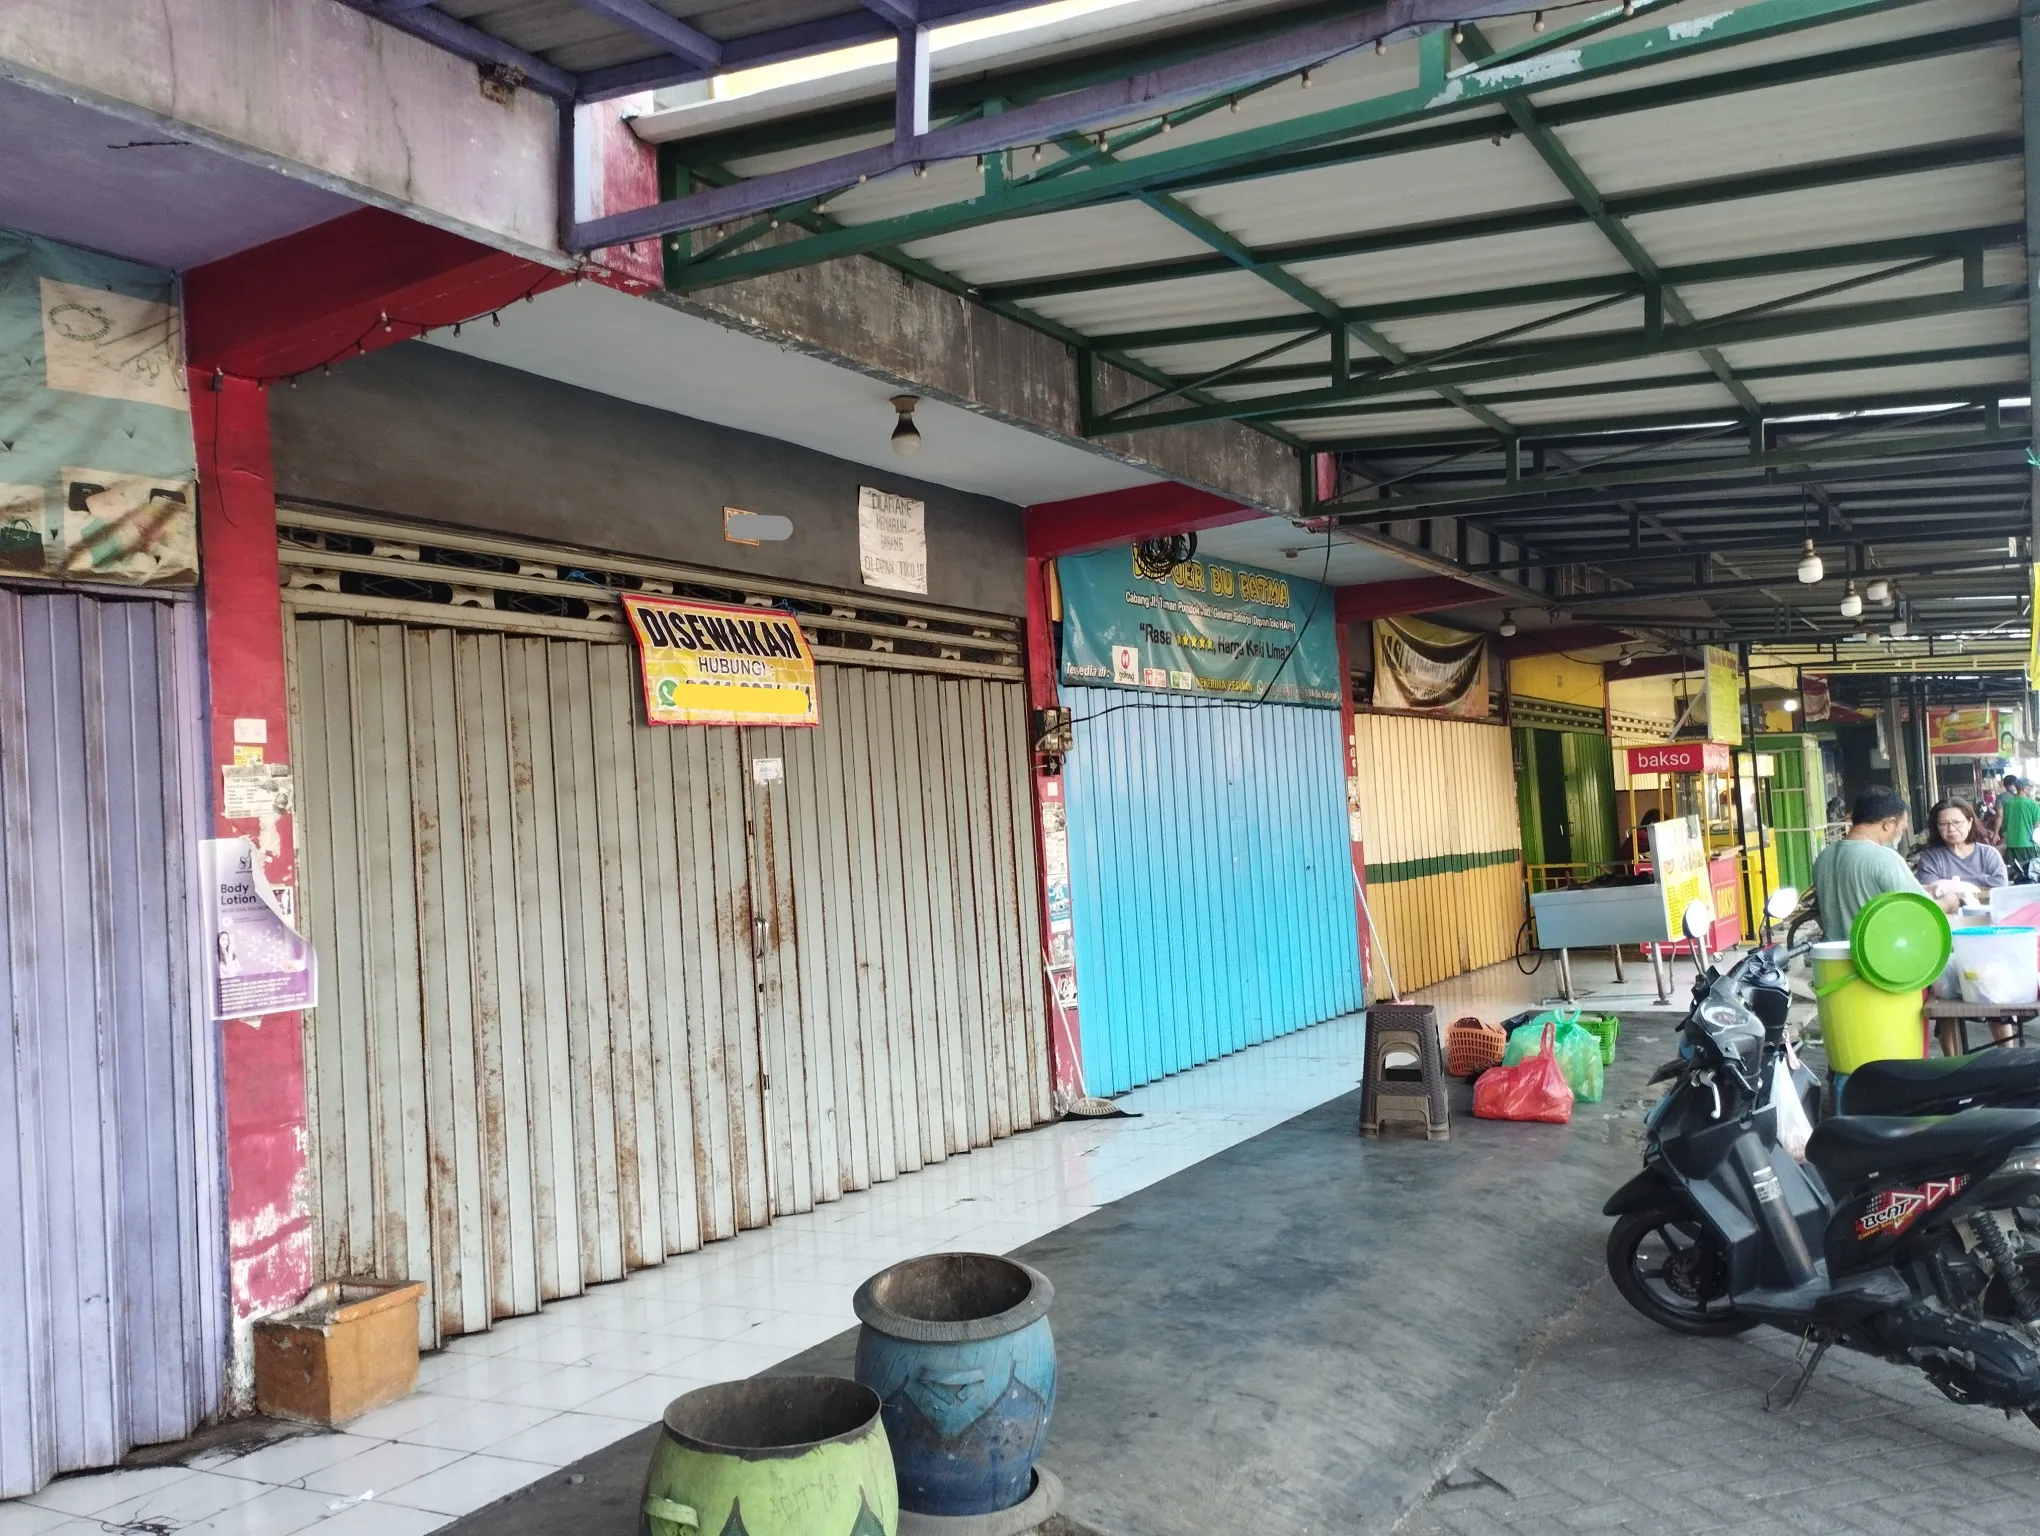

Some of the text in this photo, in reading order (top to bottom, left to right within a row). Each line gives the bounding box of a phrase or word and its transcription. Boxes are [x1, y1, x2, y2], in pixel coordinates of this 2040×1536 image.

[1208, 564, 1234, 599] BU
[1238, 571, 1289, 608] FATMA
[1125, 591, 1149, 608] Cabang
[1178, 601, 1200, 615] Pondok
[637, 608, 802, 659] DISEWAKAN
[698, 657, 767, 676] HUBUNGI
[1638, 751, 1690, 768] bakso
[221, 883, 249, 894] Body
[221, 895, 257, 905] Lotion
